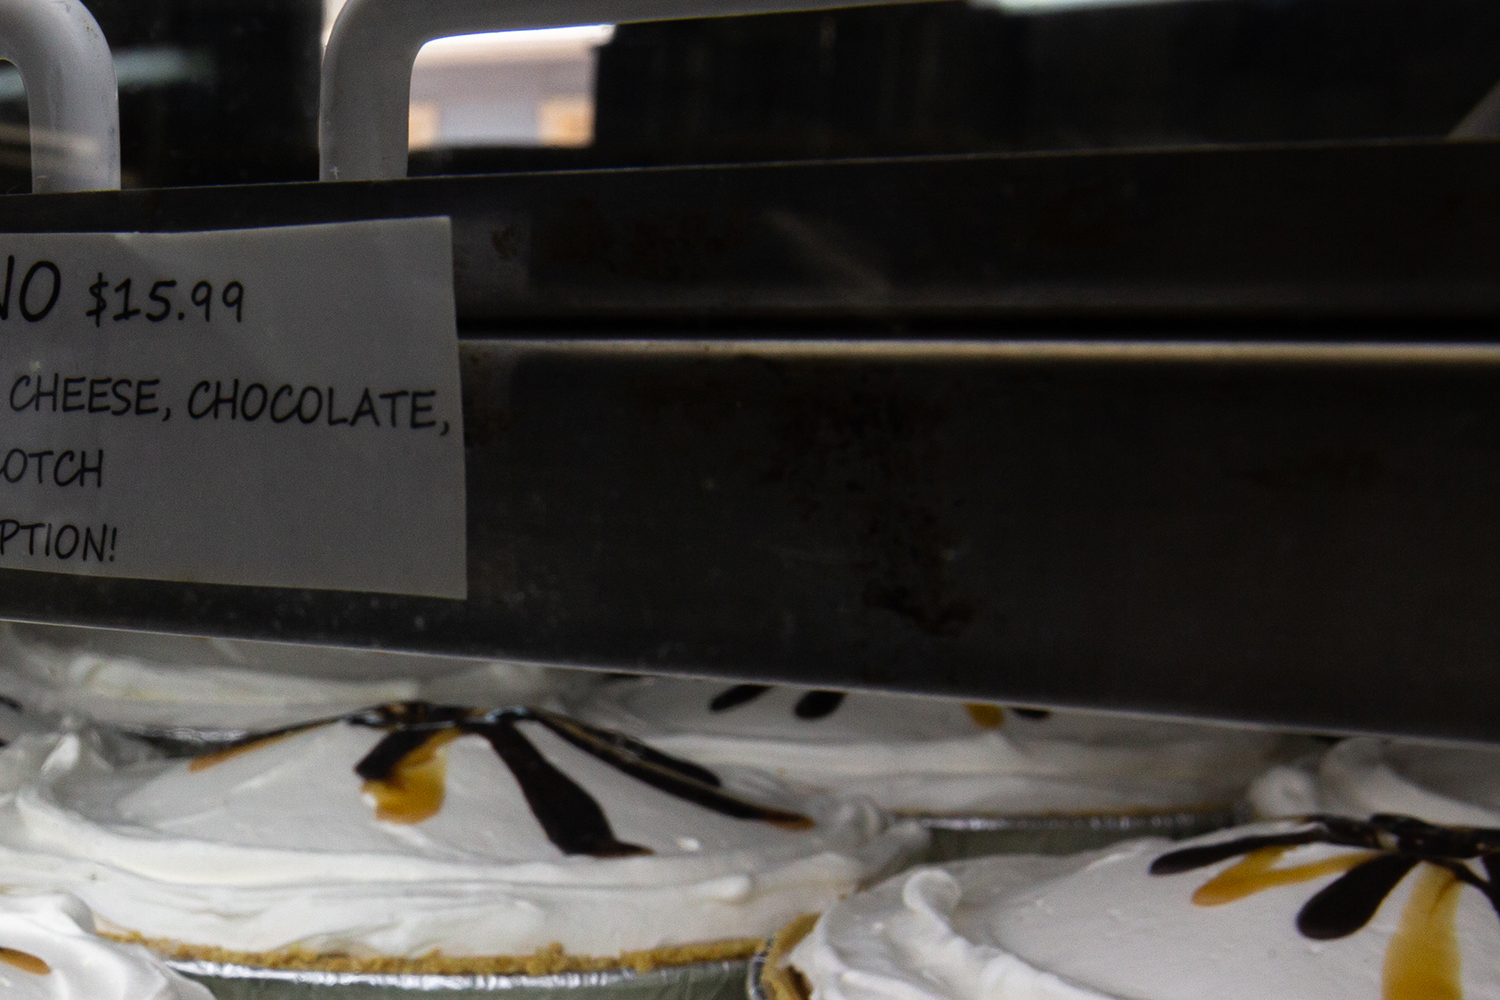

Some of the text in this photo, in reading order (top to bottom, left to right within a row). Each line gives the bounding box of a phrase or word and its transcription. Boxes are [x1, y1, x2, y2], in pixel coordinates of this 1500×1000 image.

[86, 272, 244, 328] $15.99
[9, 373, 171, 422] CHEESE,
[187, 379, 449, 436] CHOCOLATE,
